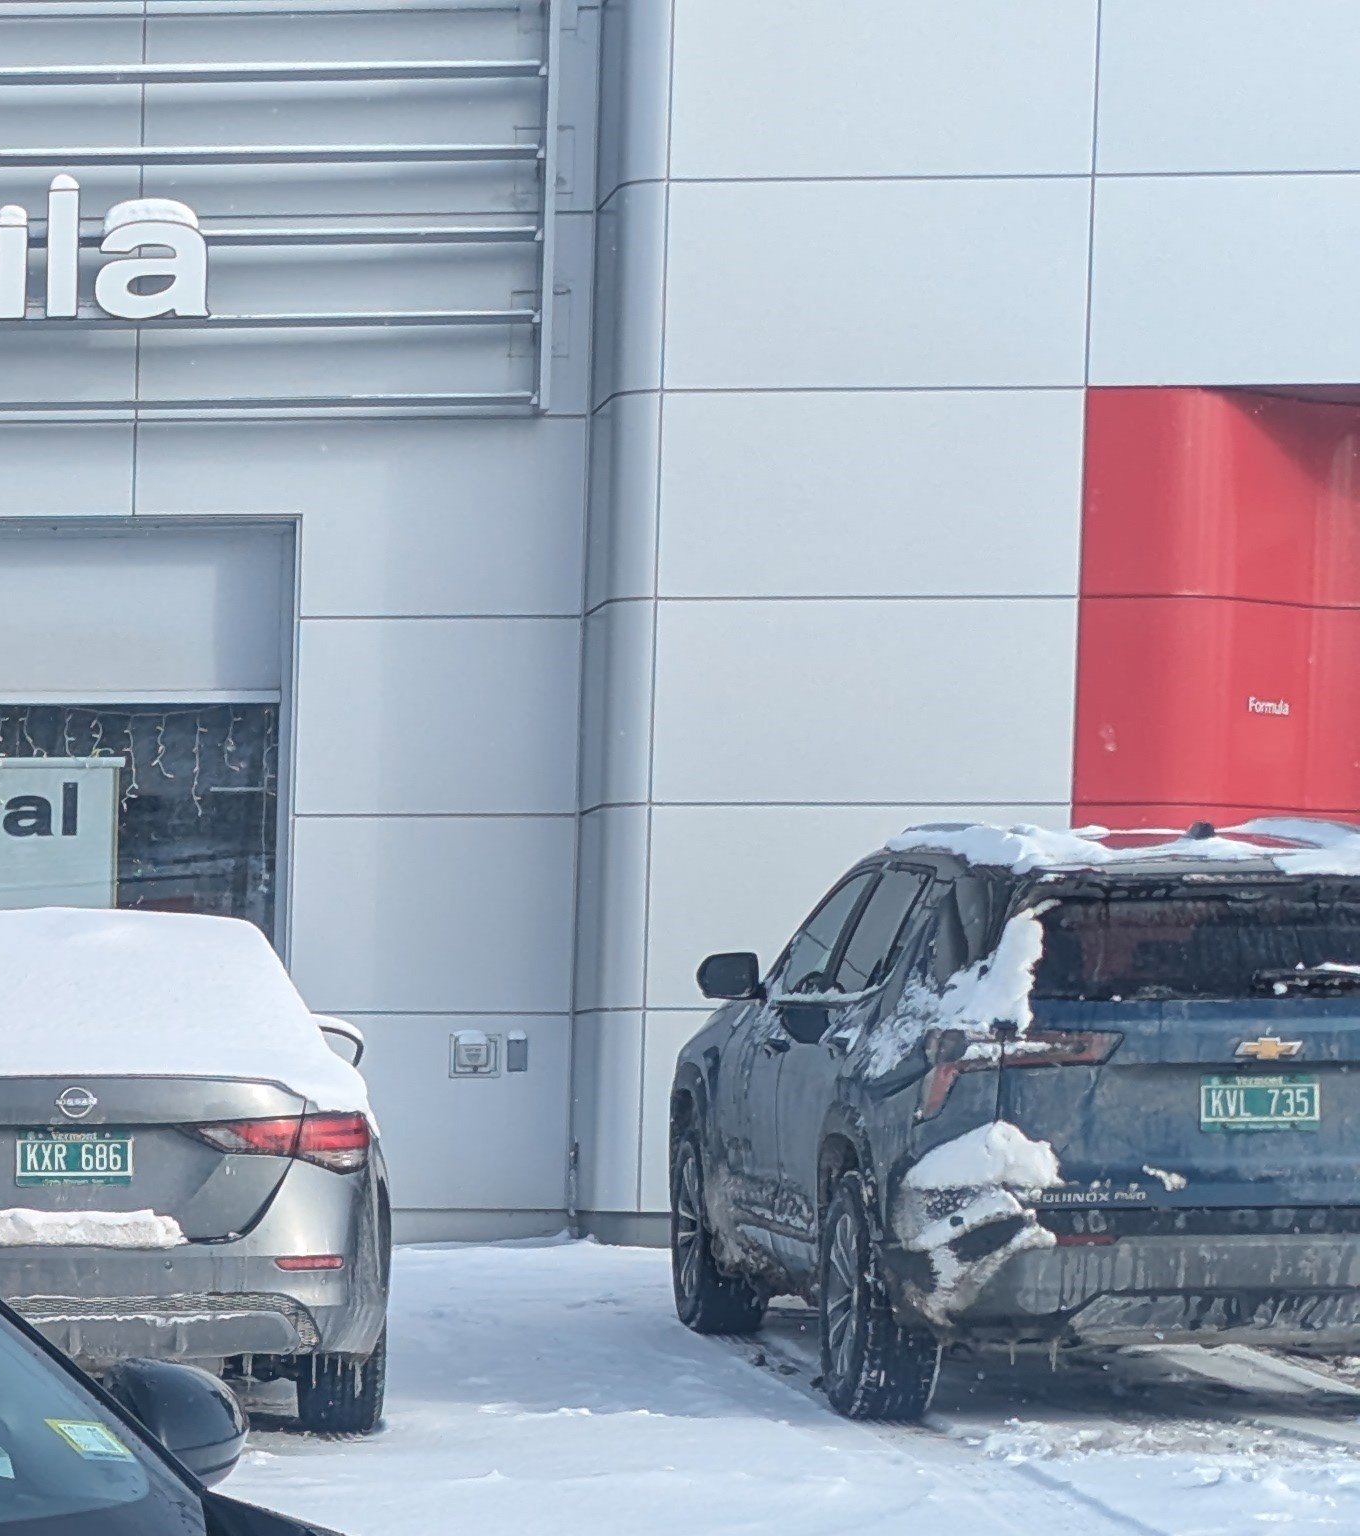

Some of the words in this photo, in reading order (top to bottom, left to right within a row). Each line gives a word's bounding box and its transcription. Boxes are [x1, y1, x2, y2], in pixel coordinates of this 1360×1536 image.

[1248, 696, 1290, 716] Formula
[1210, 1088, 1252, 1117] KVL
[1266, 1088, 1310, 1117] 735
[26, 1143, 68, 1171] KXR
[81, 1143, 122, 1171] 686
[1033, 1191, 1110, 1204] QUINOX
